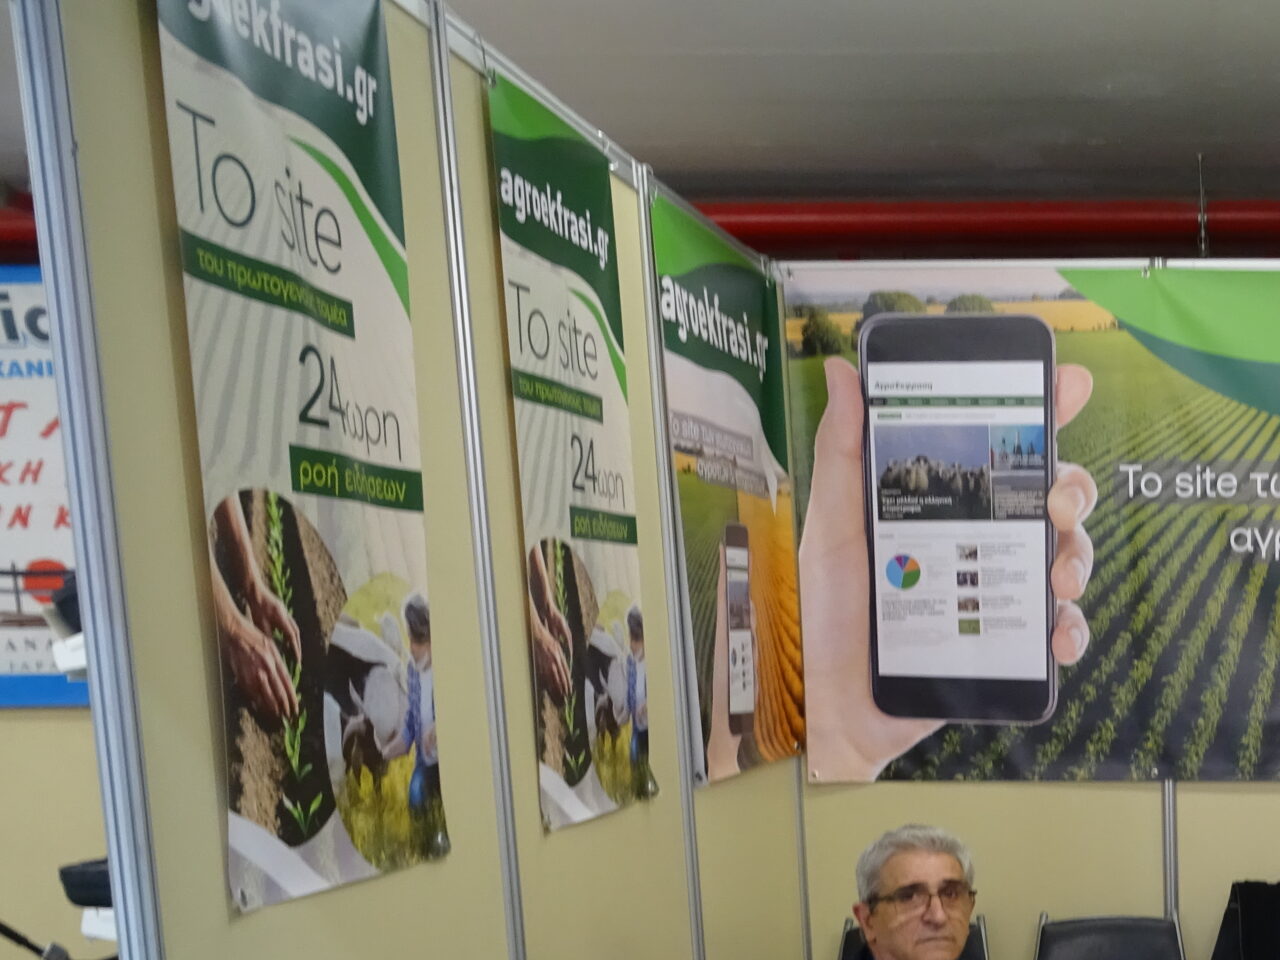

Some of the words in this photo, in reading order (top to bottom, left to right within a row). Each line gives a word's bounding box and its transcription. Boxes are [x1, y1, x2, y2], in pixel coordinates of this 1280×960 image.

[187, 0, 377, 125] oekfrasi.gr
[273, 166, 343, 275] site
[501, 167, 610, 270] agroekfrasi.gr
[227, 260, 314, 311] πρωτογεν
[661, 274, 768, 381] agroekfrasi.gr
[558, 308, 599, 382] site
[570, 432, 626, 509] 24ωρη
[1174, 464, 1237, 500] site
